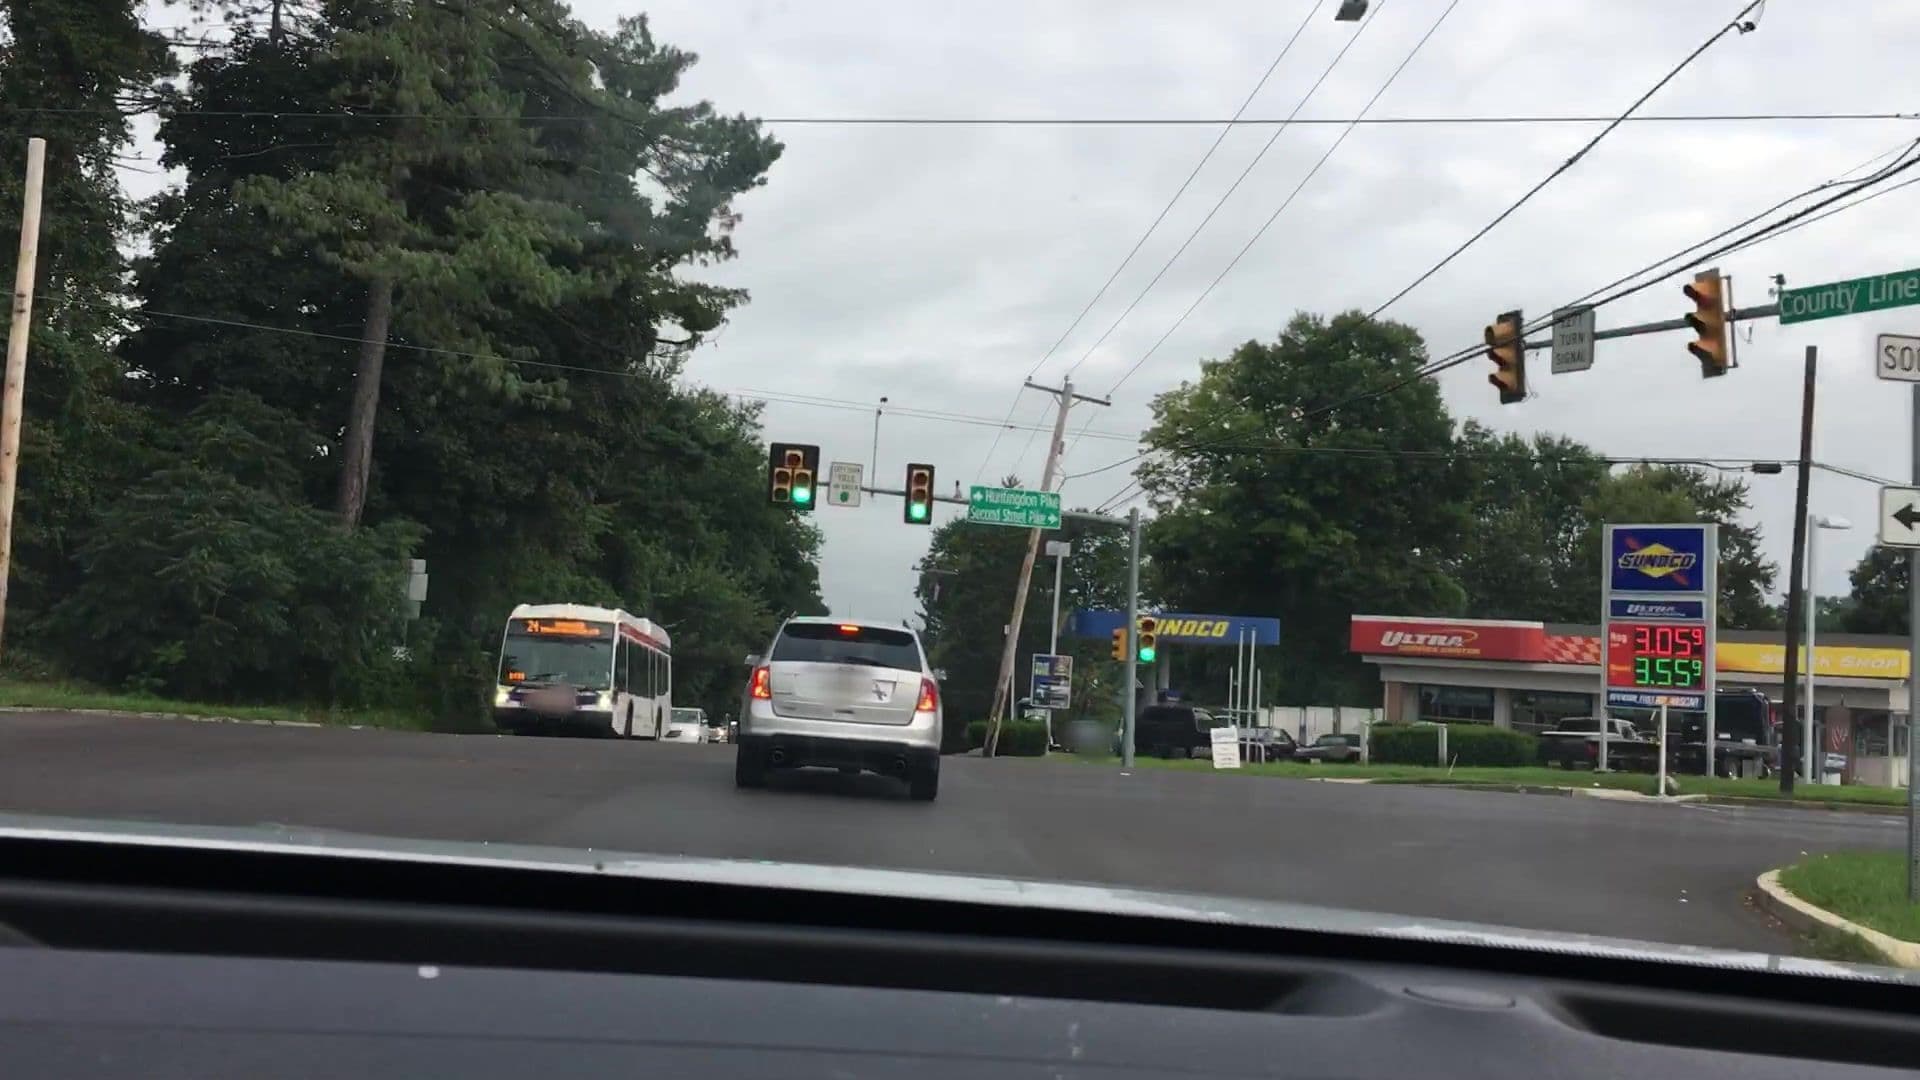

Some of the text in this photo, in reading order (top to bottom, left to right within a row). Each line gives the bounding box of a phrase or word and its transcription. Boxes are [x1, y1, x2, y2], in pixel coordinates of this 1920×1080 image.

[1780, 274, 1919, 317] County Line
[1560, 332, 1585, 345] TURN
[1556, 350, 1587, 366] SIGNAL
[1884, 345, 1920, 372] SO
[985, 490, 1059, 509] Huntingdon Pike
[970, 506, 1046, 524] Second Street Pike
[1620, 553, 1694, 569] SUNOCO
[1381, 631, 1464, 647] ULTRA
